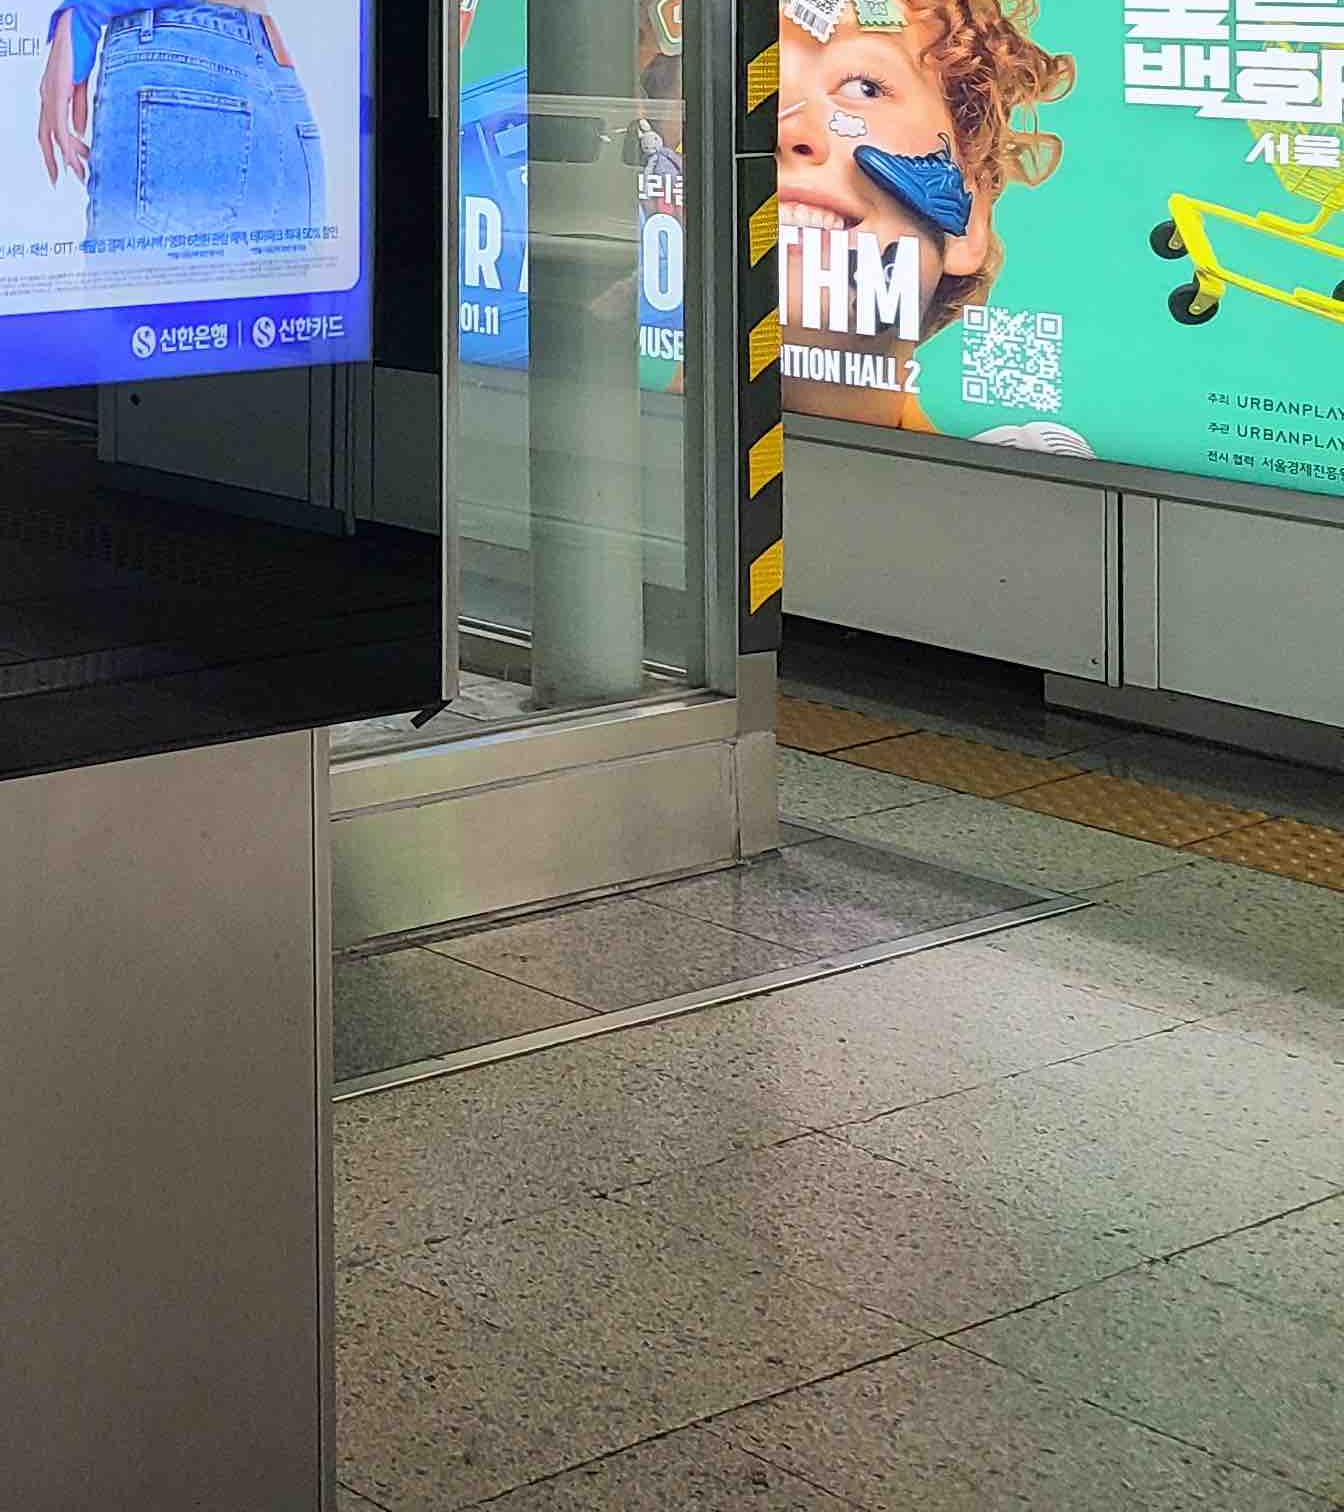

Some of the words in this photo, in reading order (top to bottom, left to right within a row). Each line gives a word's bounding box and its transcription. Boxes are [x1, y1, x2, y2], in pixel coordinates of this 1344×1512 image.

[1244, 132, 1341, 169] 서울
[54, 241, 74, 255] OTT
[159, 323, 228, 353] 신한은행
[278, 315, 345, 343] 신한카드
[845, 351, 901, 392] HALL
[904, 360, 920, 393] 2
[1207, 450, 1229, 463] 전시
